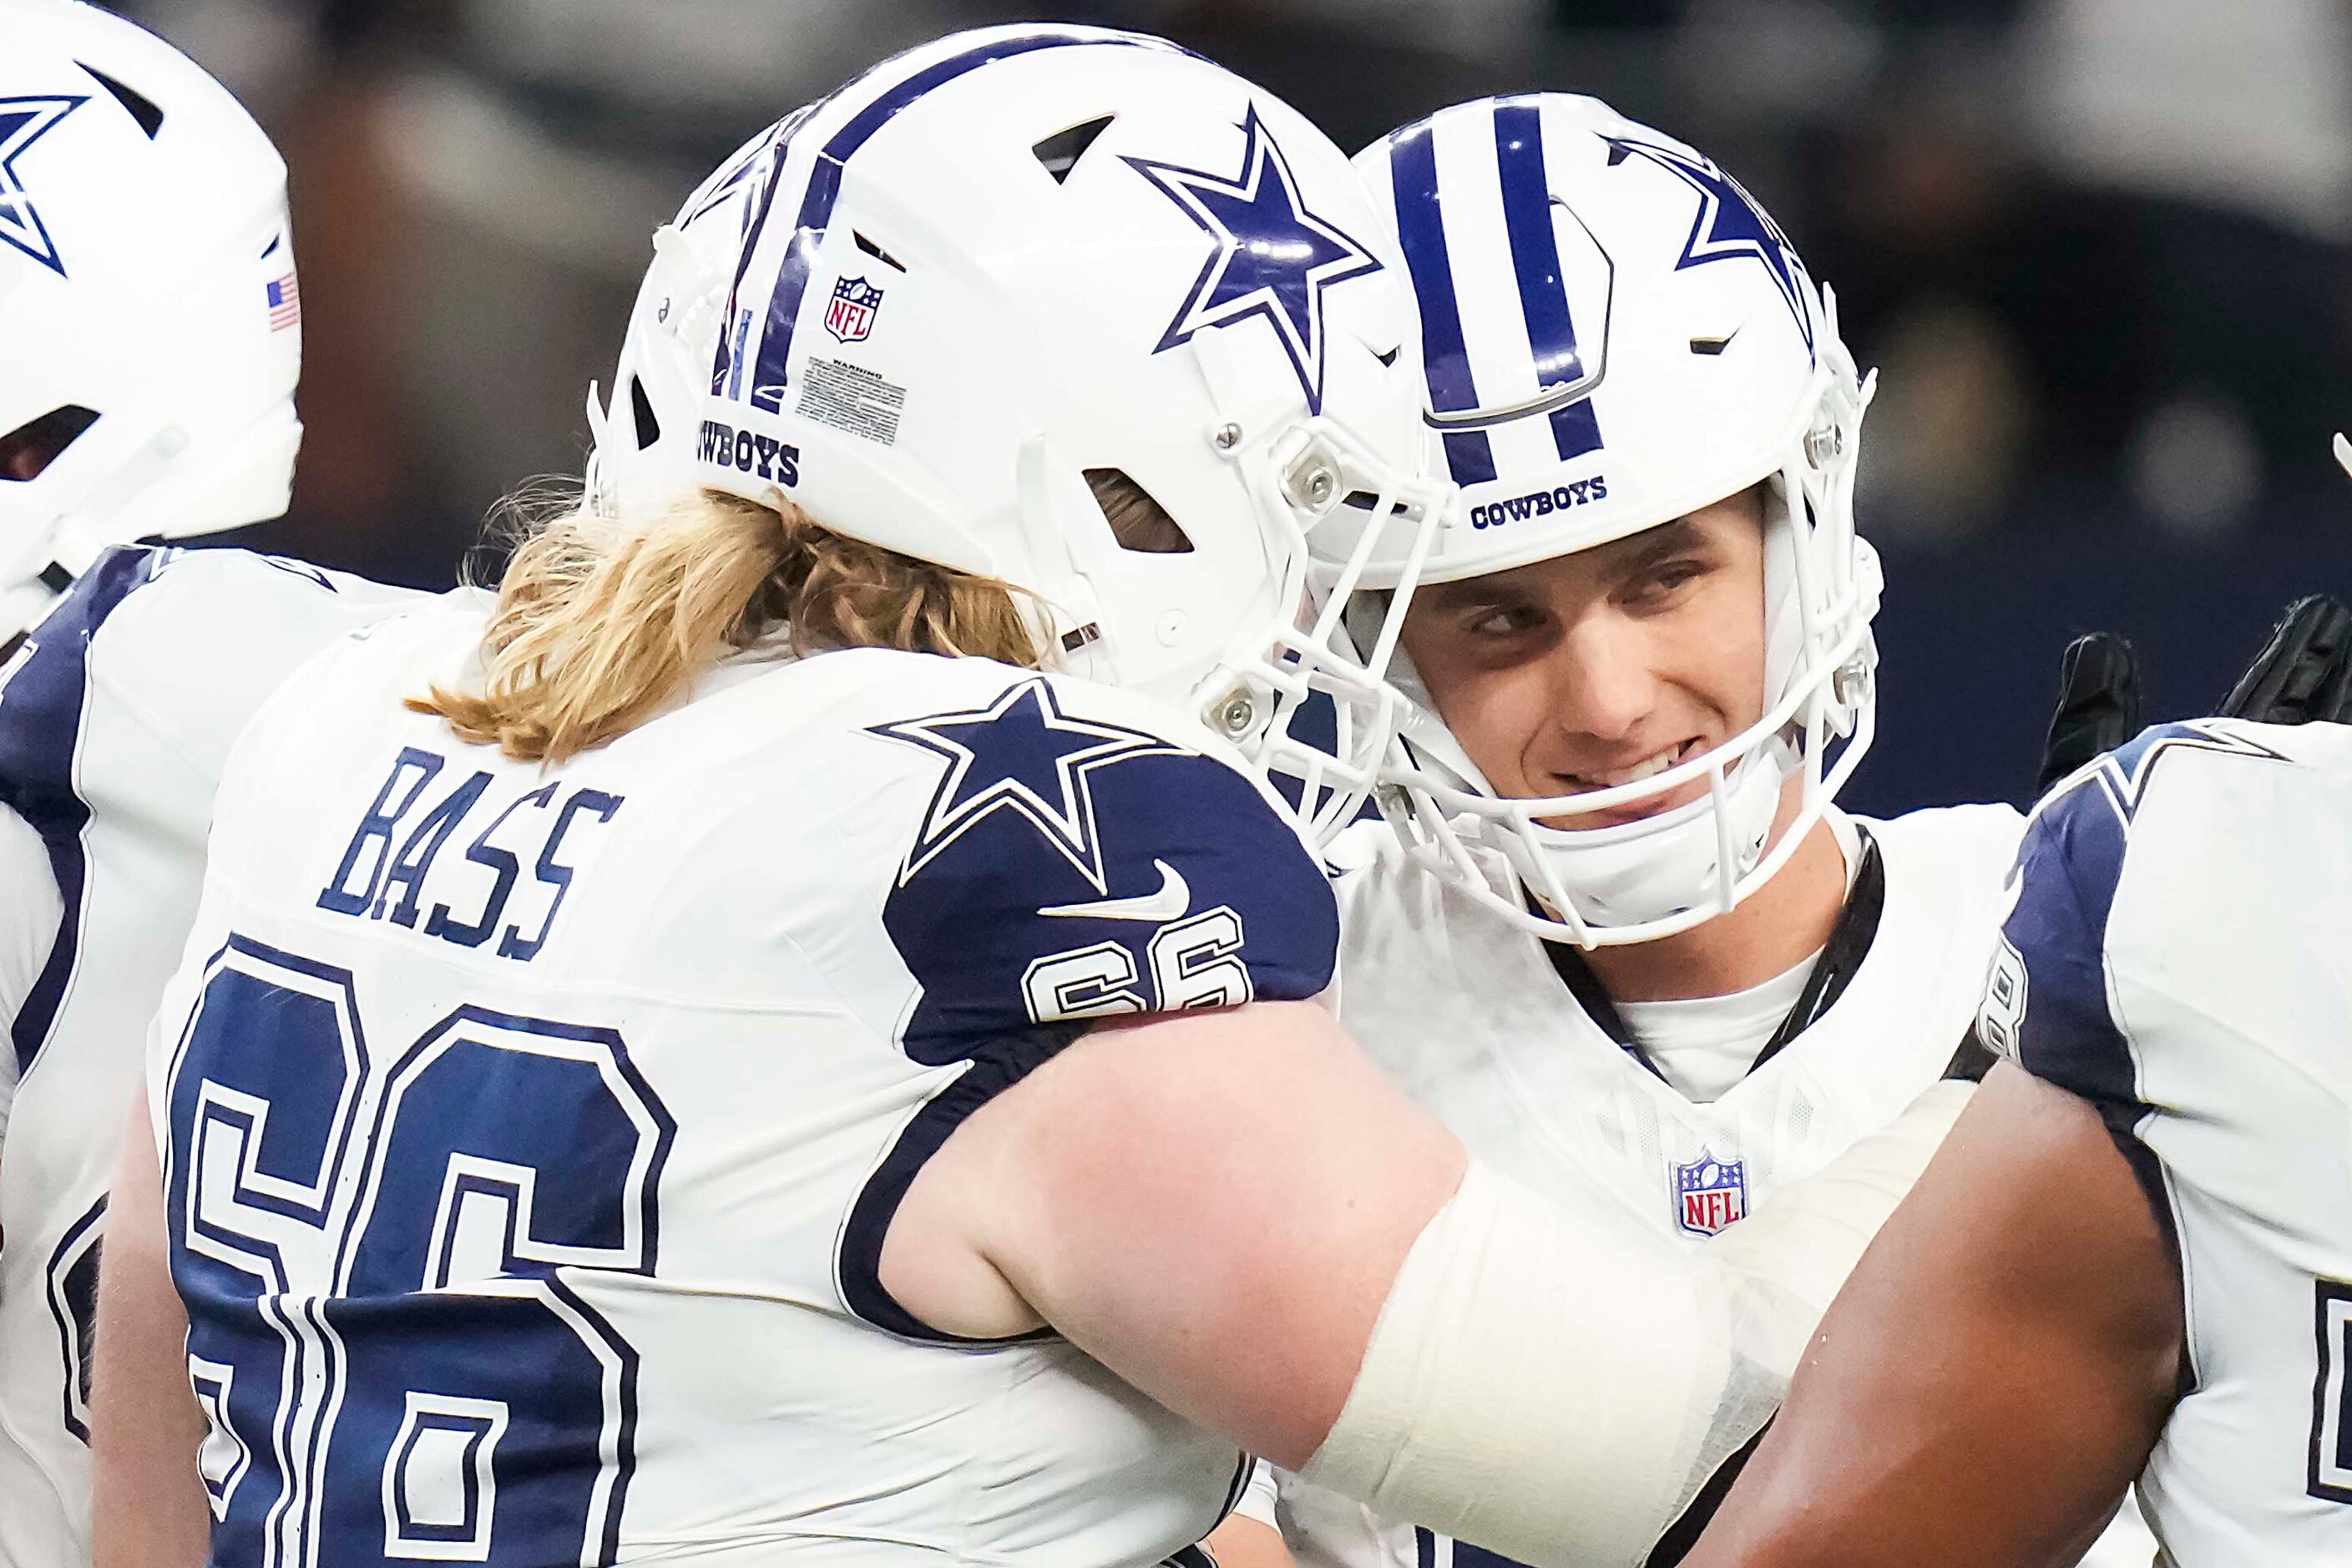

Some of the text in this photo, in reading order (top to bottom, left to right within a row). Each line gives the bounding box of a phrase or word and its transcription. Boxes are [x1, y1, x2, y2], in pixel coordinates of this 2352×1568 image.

[828, 300, 867, 336] NFL
[696, 420, 800, 488] WBOYS
[1470, 475, 1607, 529] COWBOYS
[316, 746, 625, 962] BASS
[1685, 1191, 1740, 1230] NFL
[164, 929, 679, 1568] 66
